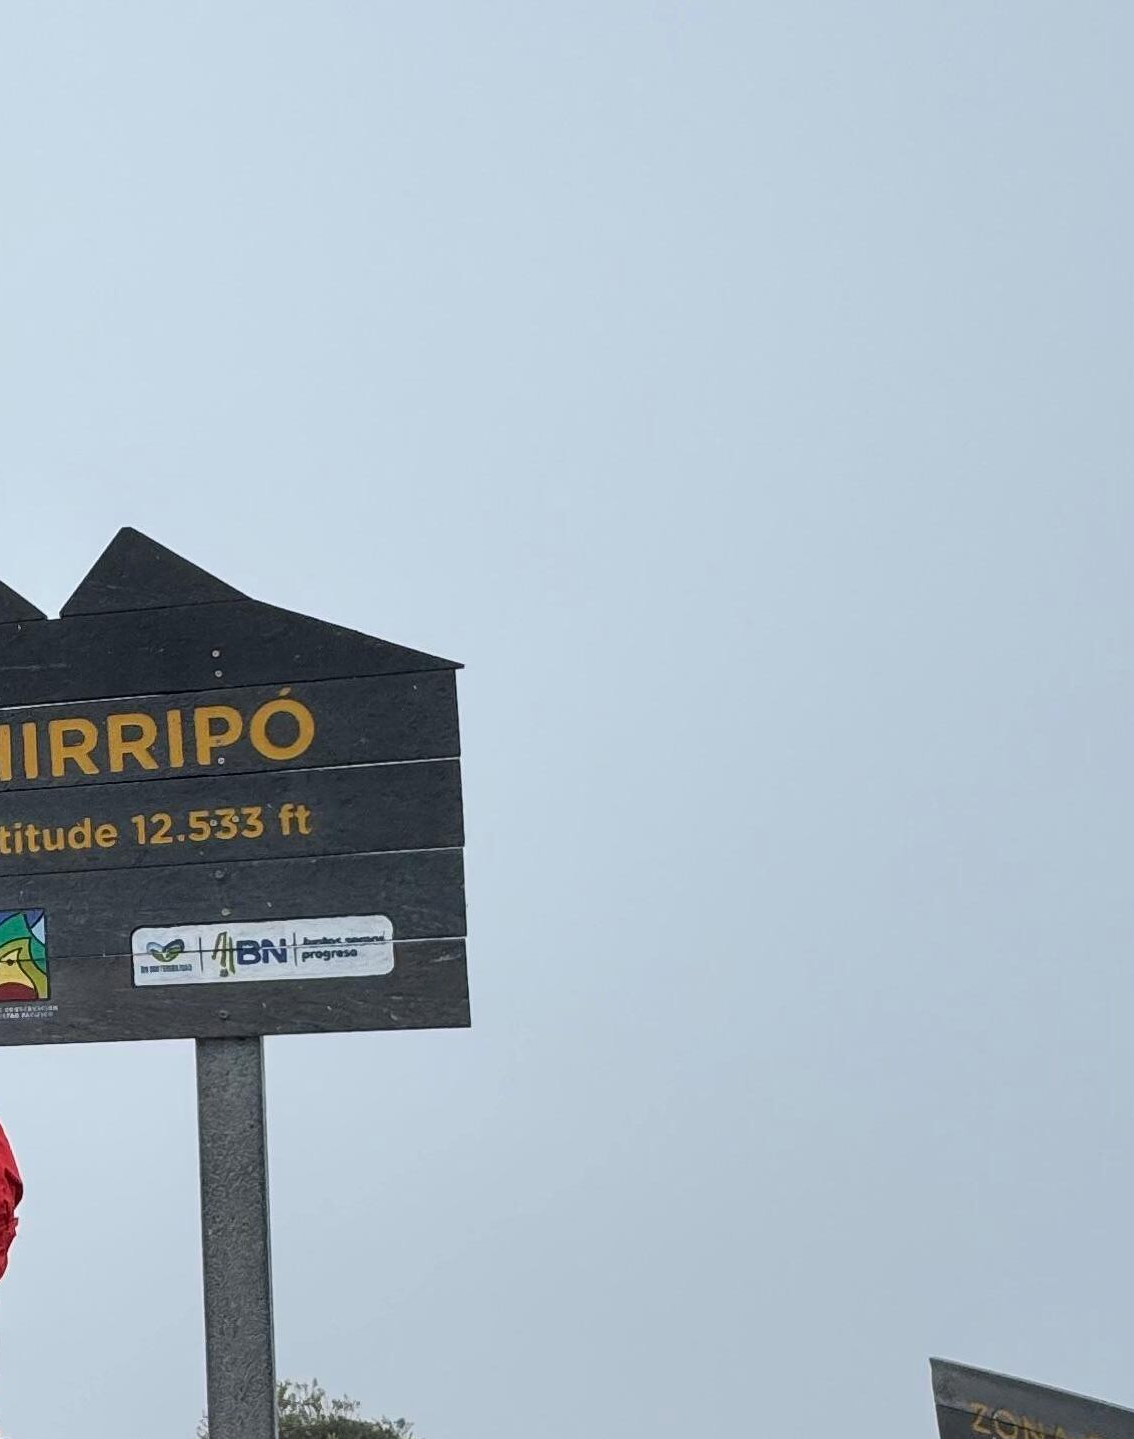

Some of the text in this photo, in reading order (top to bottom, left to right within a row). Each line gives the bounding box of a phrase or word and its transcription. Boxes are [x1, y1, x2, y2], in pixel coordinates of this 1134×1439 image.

[131, 804, 263, 846] 12.533
[278, 802, 312, 836] ft
[236, 938, 287, 965] BN
